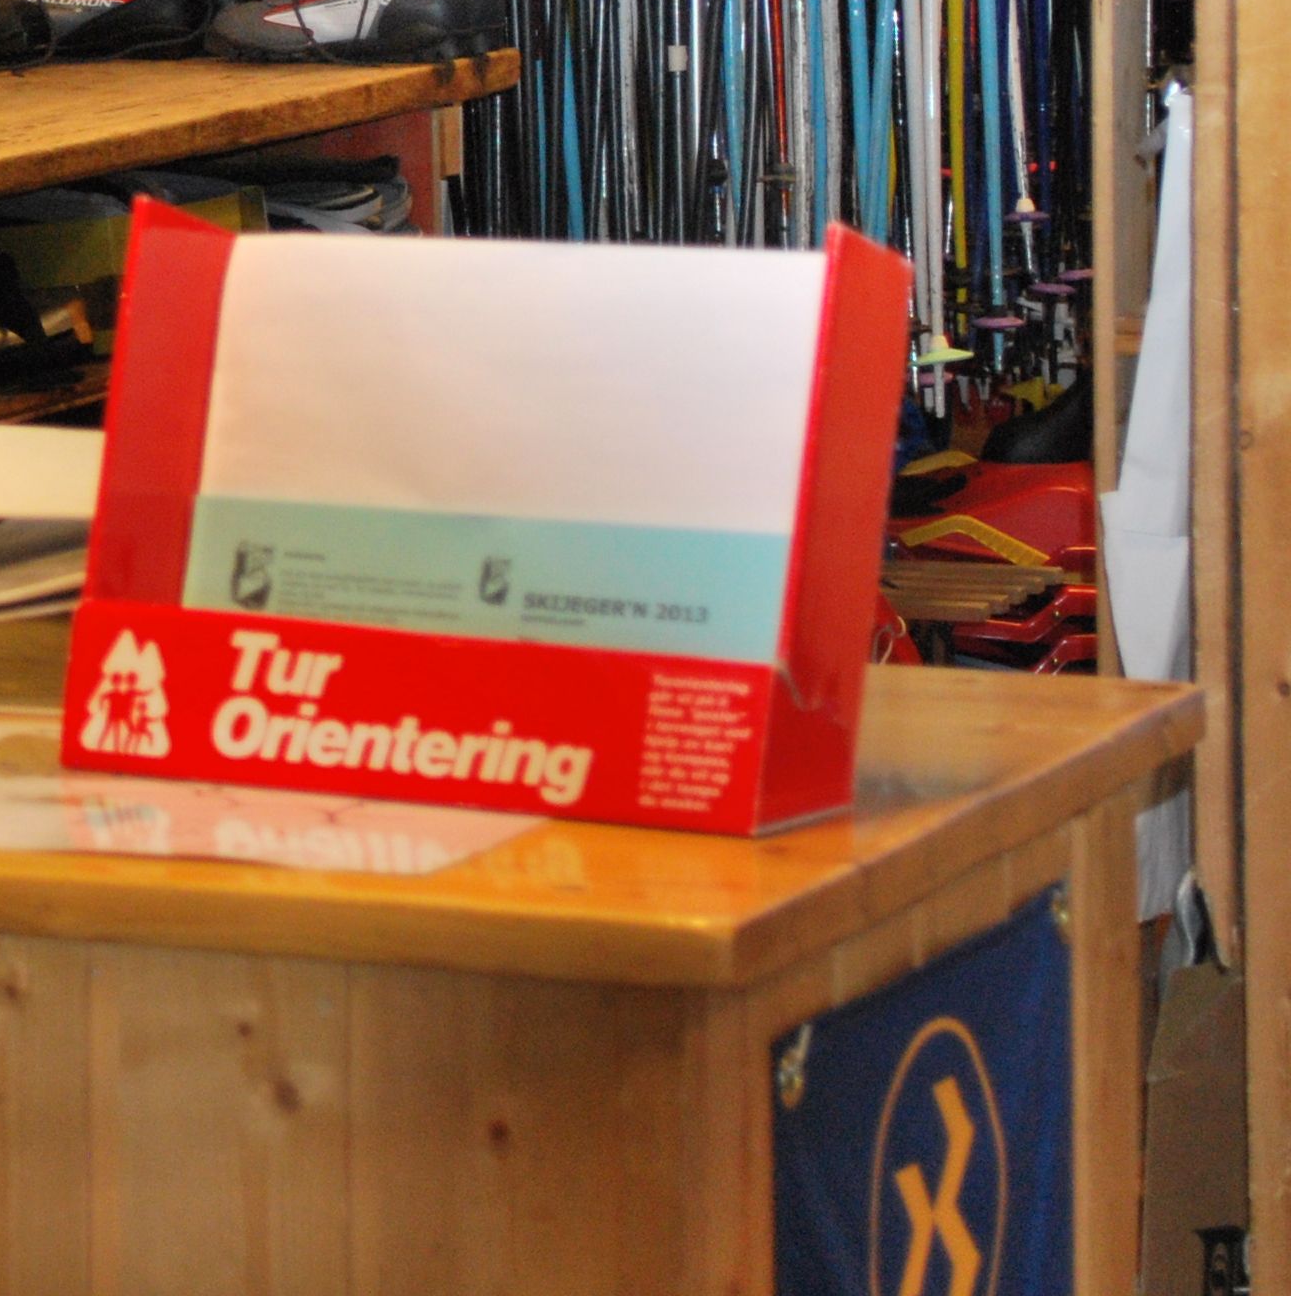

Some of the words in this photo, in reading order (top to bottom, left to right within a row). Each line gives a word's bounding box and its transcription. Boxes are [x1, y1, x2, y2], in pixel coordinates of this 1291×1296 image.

[654, 602, 710, 625] 2013
[229, 629, 344, 698] Tur
[209, 694, 594, 805] Orientering
